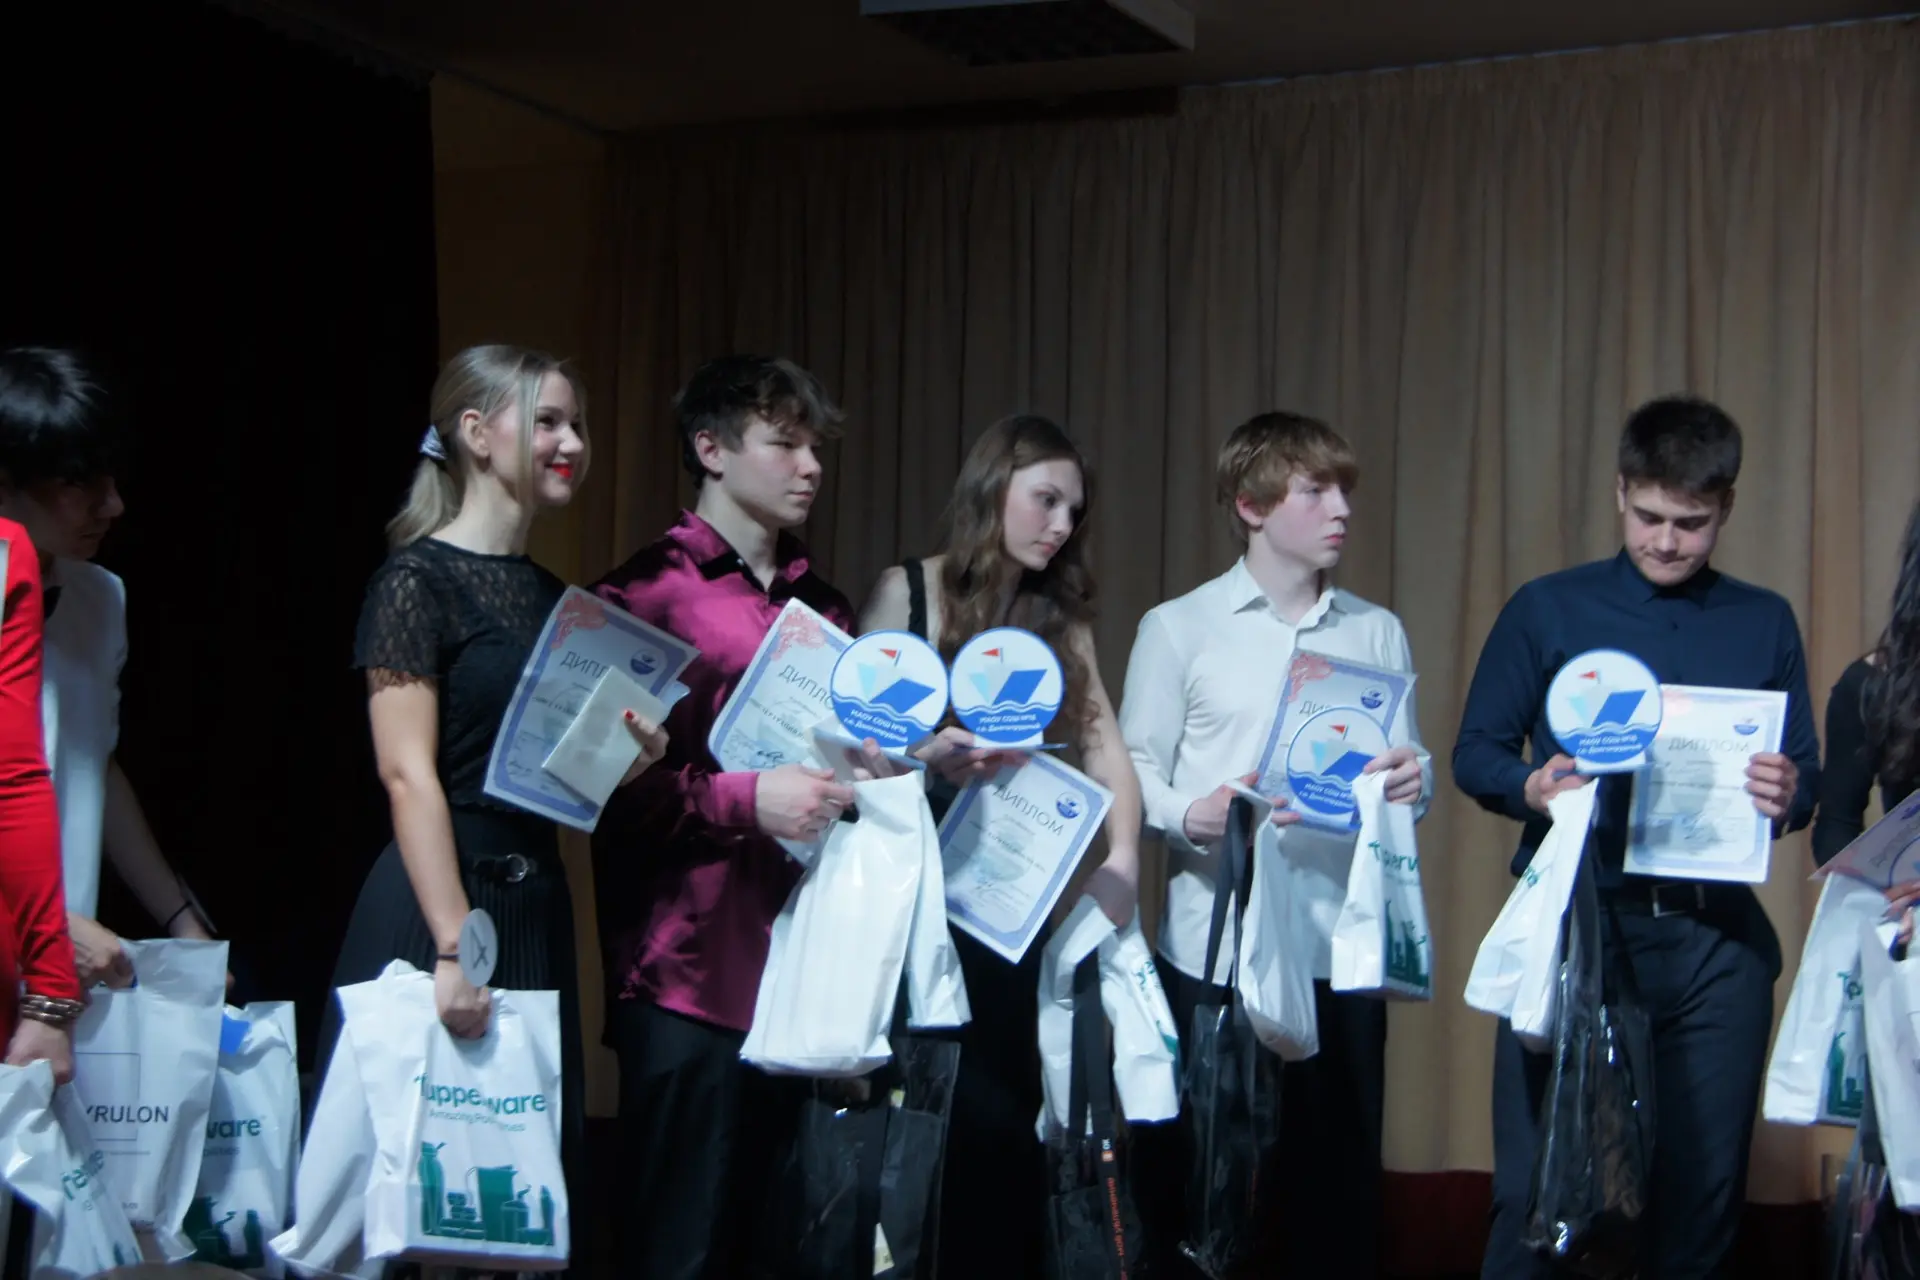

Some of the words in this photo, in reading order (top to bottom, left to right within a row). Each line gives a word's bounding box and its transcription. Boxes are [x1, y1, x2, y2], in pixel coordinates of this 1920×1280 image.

[560, 650, 610, 679] ДИПЛ
[778, 664, 832, 710] ДИПЛО
[1668, 737, 1750, 752] ДИПЛОМ
[992, 783, 1064, 836] ДИПЛОМ
[413, 1072, 546, 1115] Tuppeware
[87, 1105, 169, 1123] RULON
